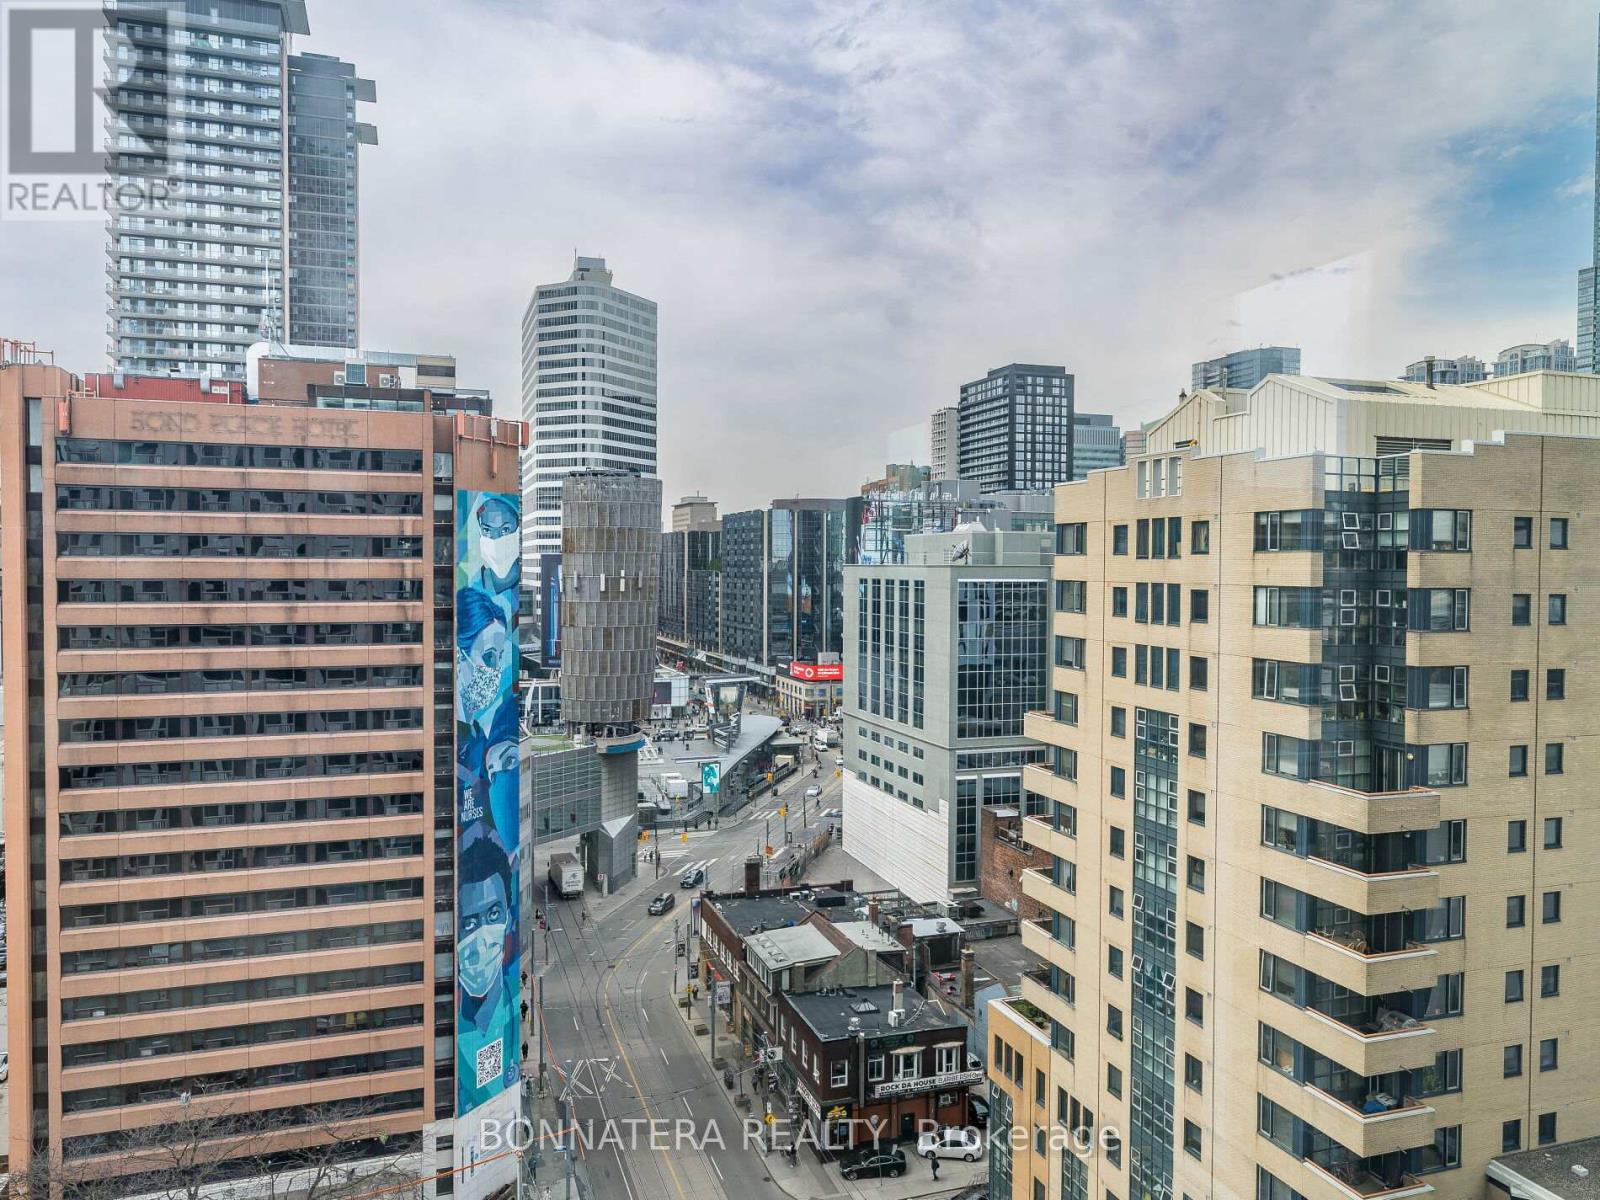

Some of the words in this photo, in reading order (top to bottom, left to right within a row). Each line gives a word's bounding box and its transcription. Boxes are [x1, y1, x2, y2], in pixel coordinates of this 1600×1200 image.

[880, 1084, 900, 1092] ROCK
[901, 1081, 912, 1089] DA
[913, 1078, 936, 1088] HOUSE
